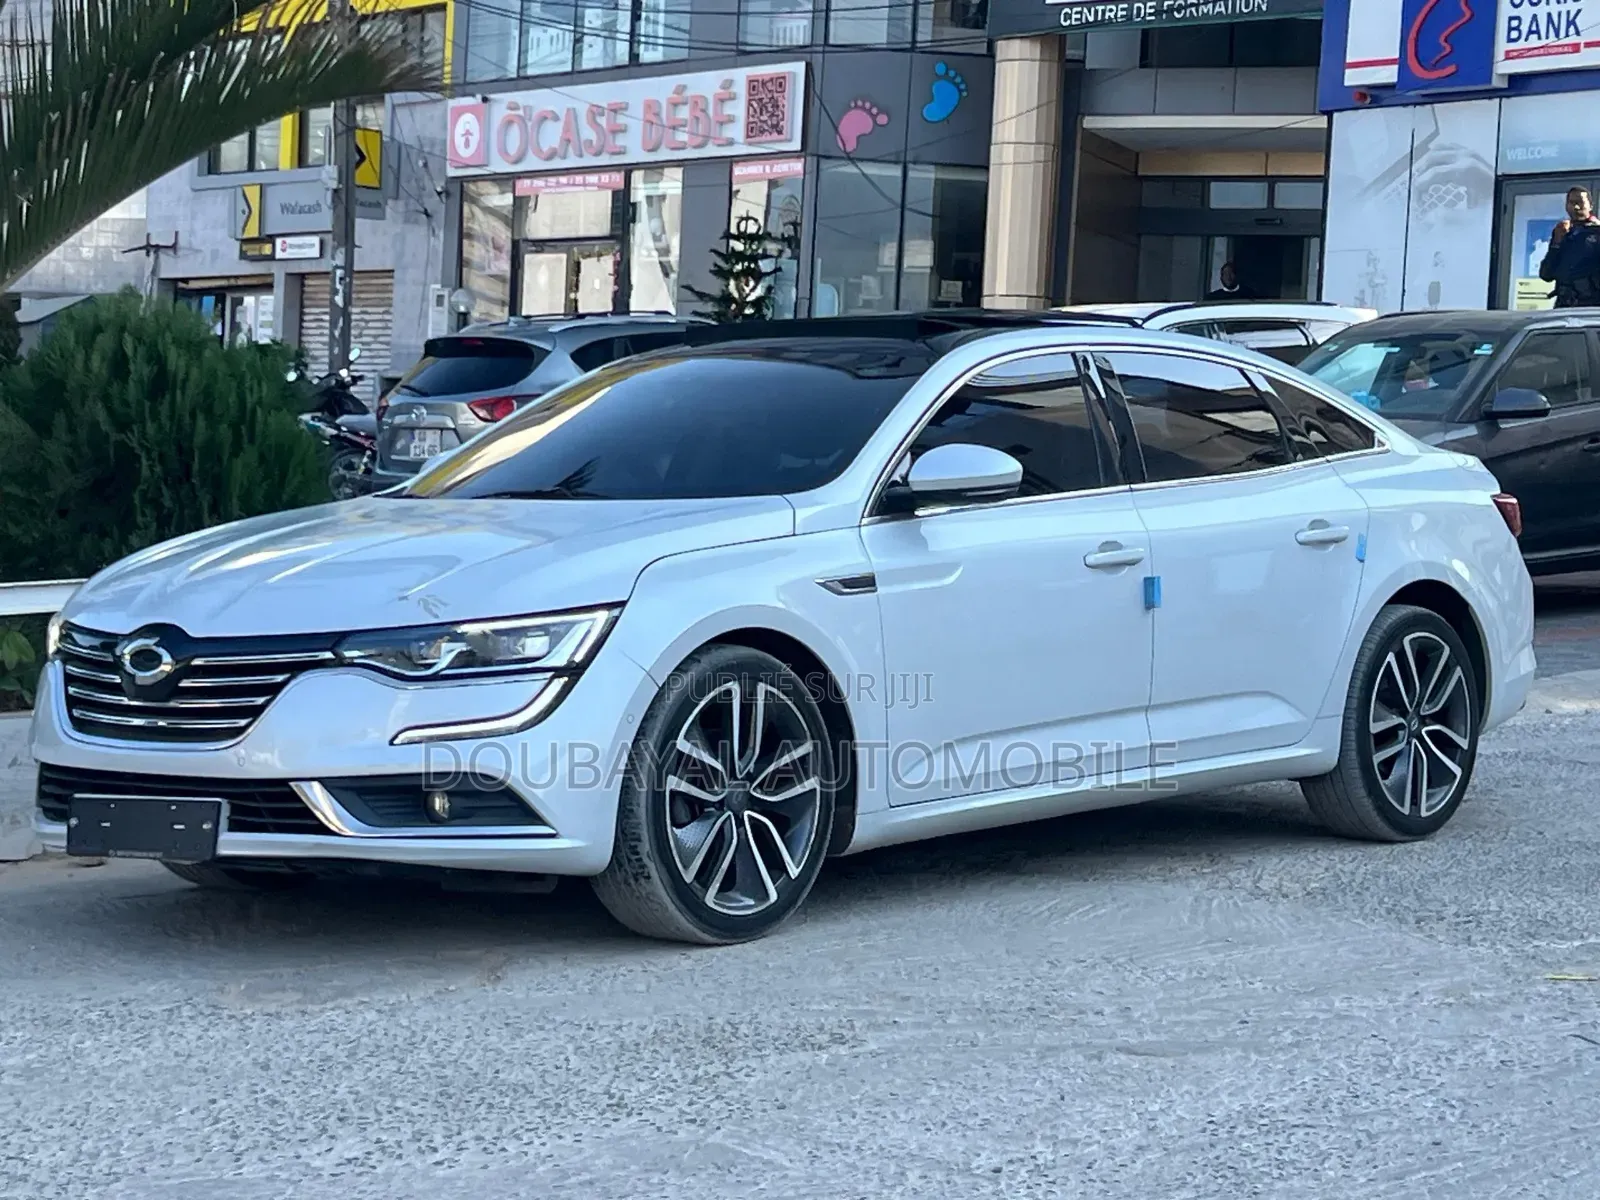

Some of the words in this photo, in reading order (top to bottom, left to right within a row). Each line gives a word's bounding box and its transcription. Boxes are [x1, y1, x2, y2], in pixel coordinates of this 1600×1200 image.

[1060, 4, 1128, 27] CENTRE
[1133, 2, 1156, 21] DE
[1162, 0, 1268, 19] FORMATION
[1506, 8, 1582, 43] BANK
[641, 79, 738, 152] BÉBÉ
